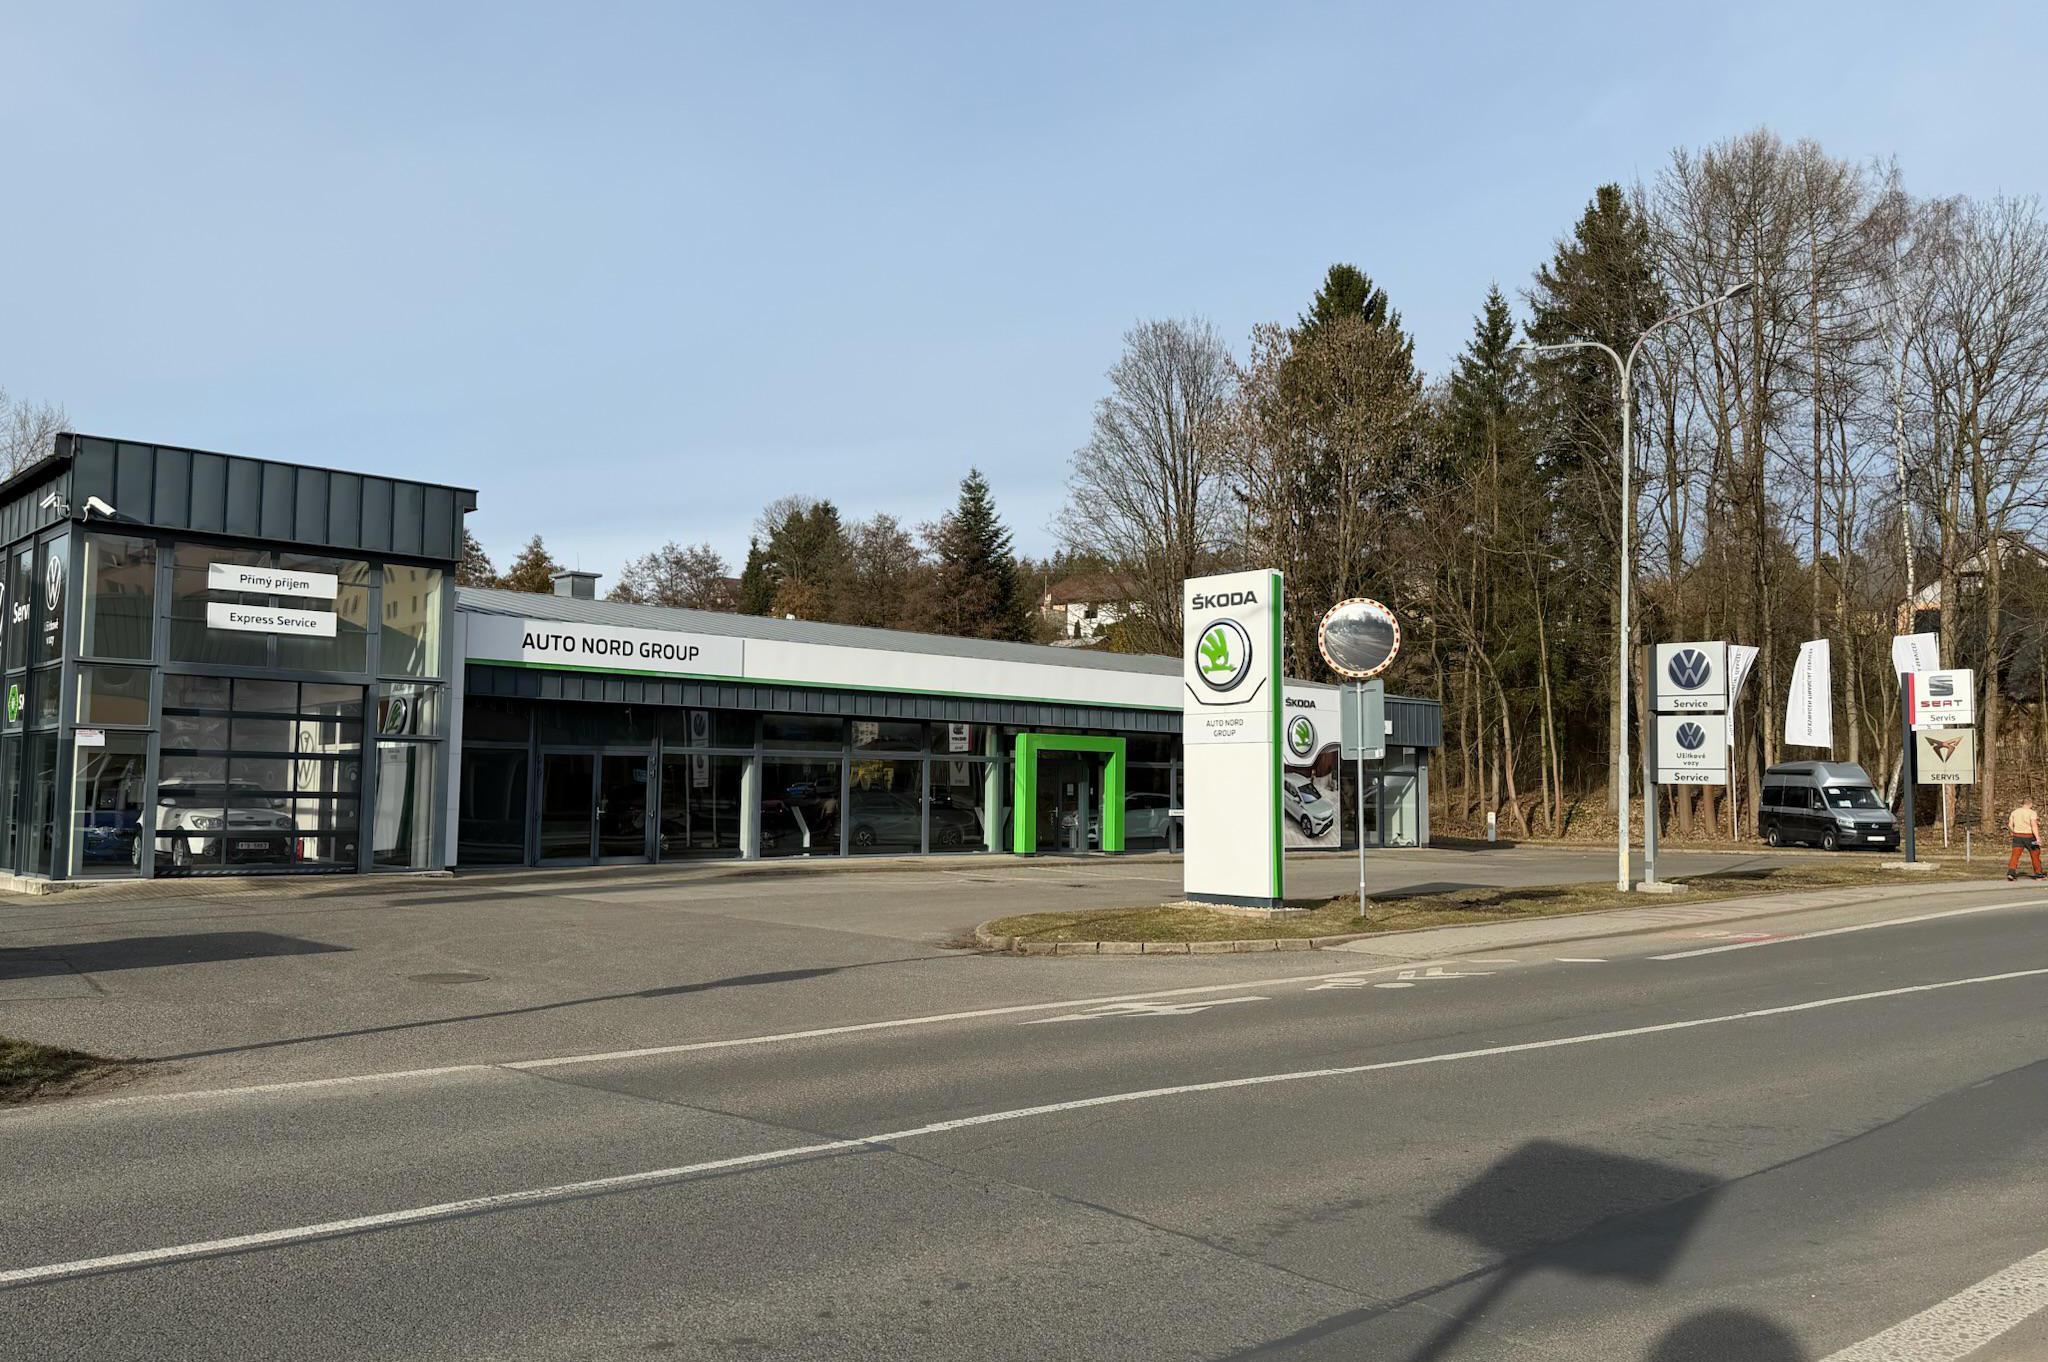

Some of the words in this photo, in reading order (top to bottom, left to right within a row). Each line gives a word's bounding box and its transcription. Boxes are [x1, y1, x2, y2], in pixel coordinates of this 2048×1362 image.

[275, 577, 310, 590] příjem
[1192, 590, 1258, 610] ŠKODA
[230, 612, 274, 625] Express
[276, 615, 317, 628] Service
[522, 633, 576, 652] AUTO
[582, 637, 634, 657] NORD
[639, 642, 699, 661] GROUP
[1285, 697, 1316, 709] ŠKODA
[1673, 699, 1709, 709] Service
[1920, 699, 1963, 708] SEAT
[1206, 719, 1224, 727] AUTO
[1224, 718, 1244, 727] NORD
[1930, 714, 1956, 722] Servis
[1213, 729, 1236, 737] GROUP
[1673, 771, 1710, 782] Service
[1930, 773, 1960, 781] SERVIS
